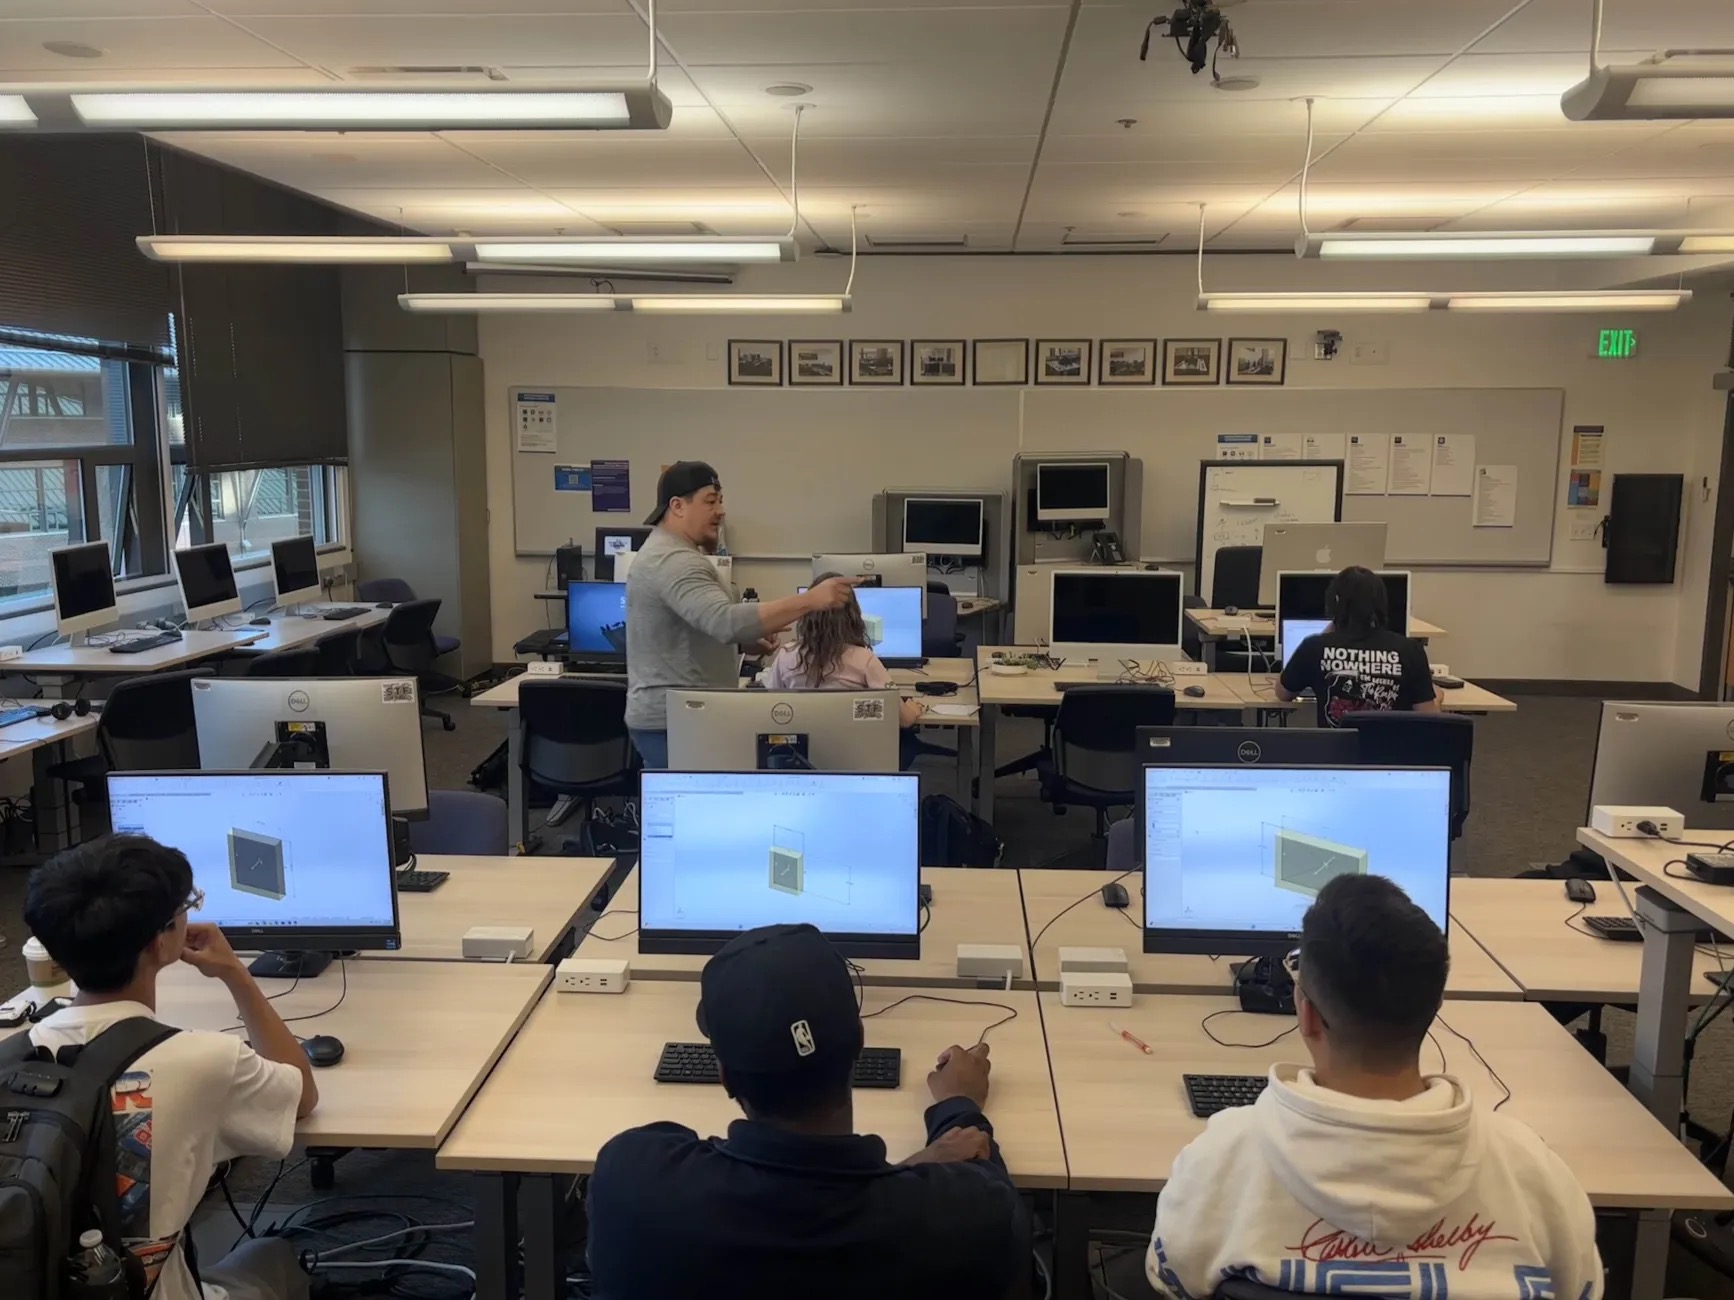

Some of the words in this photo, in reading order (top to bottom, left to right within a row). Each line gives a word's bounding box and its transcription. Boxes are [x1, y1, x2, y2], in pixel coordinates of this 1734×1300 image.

[1599, 329, 1633, 357] EXIT
[1324, 647, 1399, 663] NOTHING
[1320, 660, 1401, 675] NOWHERE
[290, 697, 308, 705] DELL
[1240, 748, 1258, 756] DELL
